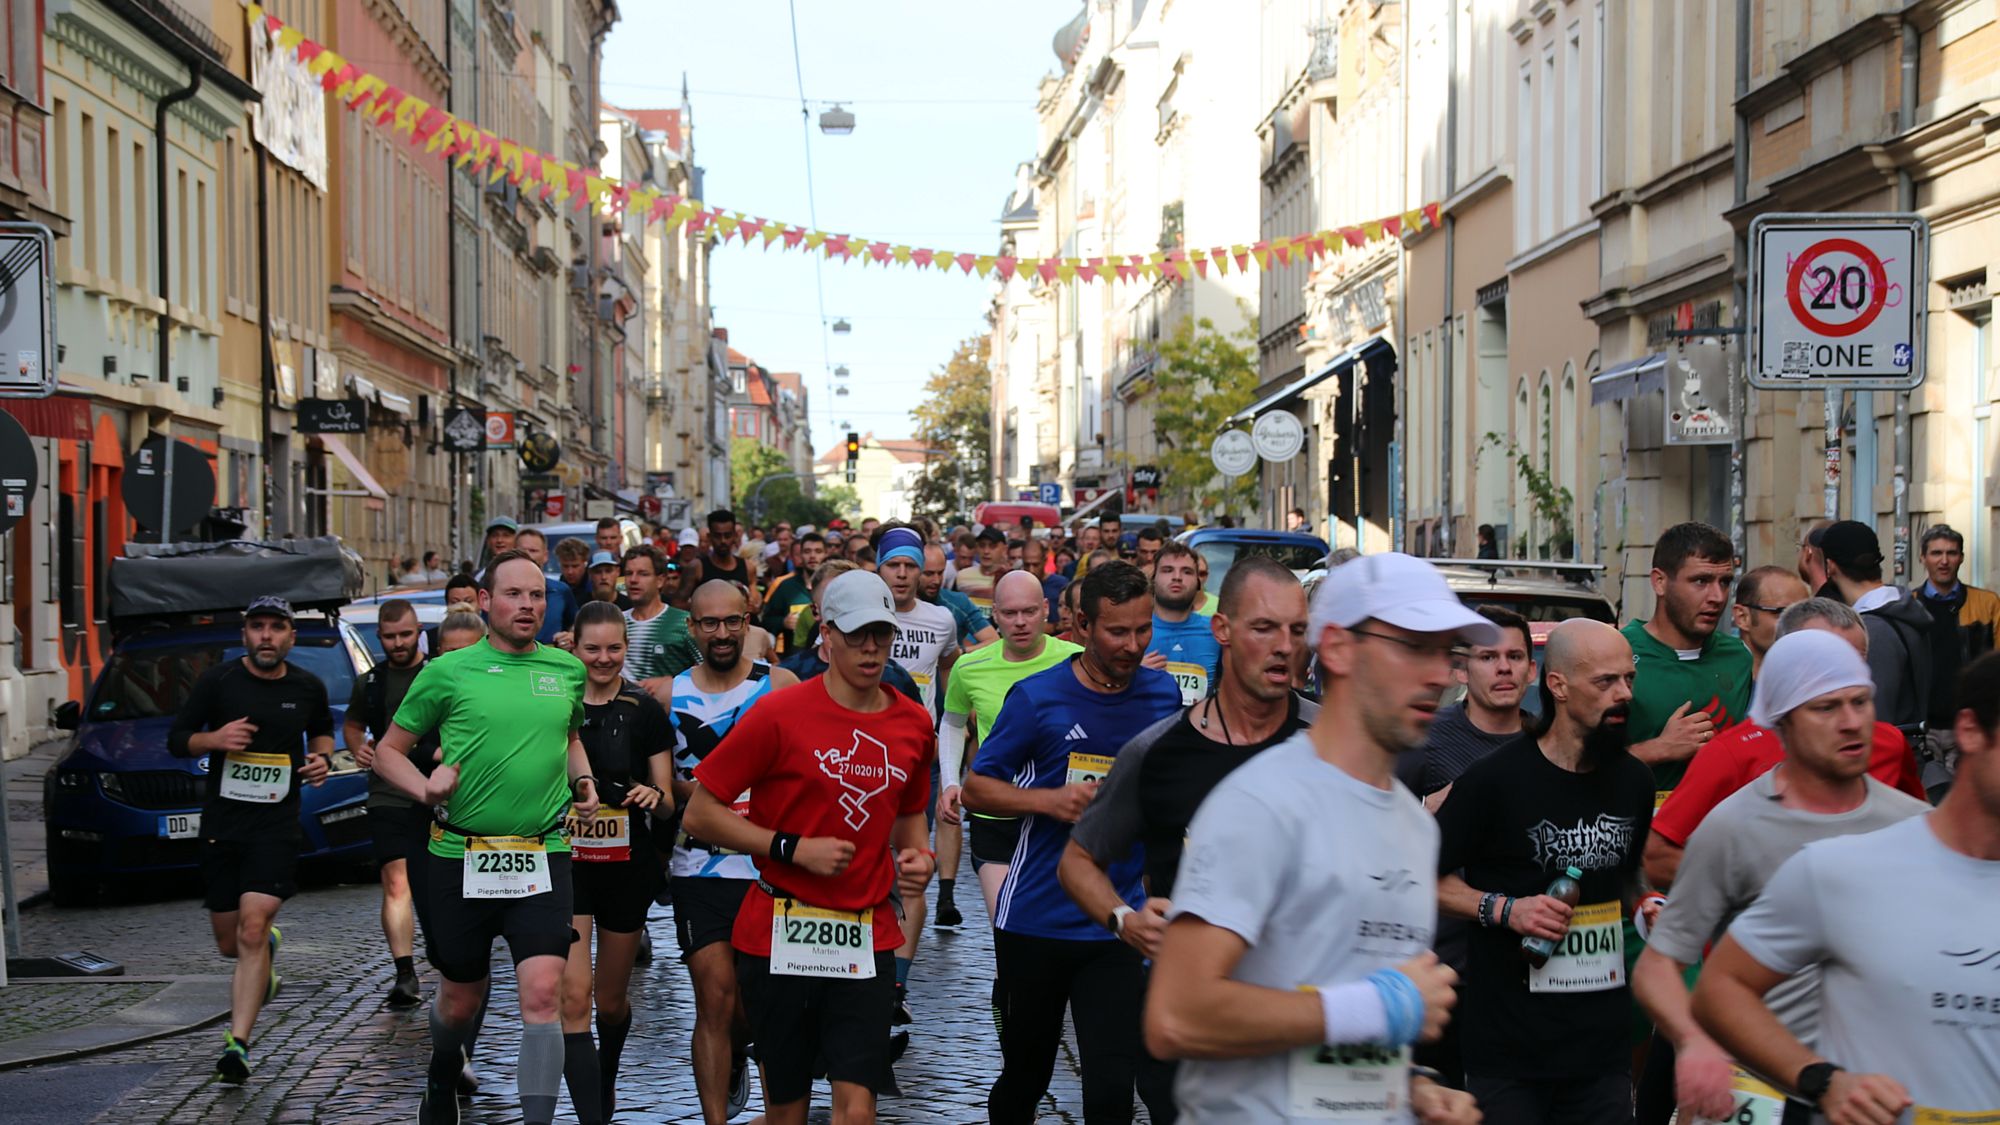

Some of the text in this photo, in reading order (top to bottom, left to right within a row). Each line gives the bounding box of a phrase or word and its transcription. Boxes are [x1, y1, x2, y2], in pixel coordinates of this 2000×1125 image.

[1811, 265, 1866, 310] 20
[1811, 344, 1873, 368] ONE
[1134, 470, 1156, 484] sky
[1043, 485, 1055, 502] P
[907, 629, 937, 645] HUTA
[893, 643, 920, 659] EAM
[539, 684, 560, 692] PLUS
[1175, 675, 1199, 690] 173
[231, 764, 282, 783] 23079
[838, 763, 884, 778] 27102019
[169, 816, 188, 834] DD
[566, 818, 618, 838] 41200
[477, 853, 536, 873] 22355
[580, 852, 611, 860] Sparkasse
[477, 887, 527, 896] Piepenbrock
[787, 919, 862, 948] 22808
[1551, 926, 1617, 957] 20041
[787, 962, 847, 974] Piepenbrock
[1549, 974, 1609, 988] Piepenbrock
[1931, 992, 2000, 1014] BORE
